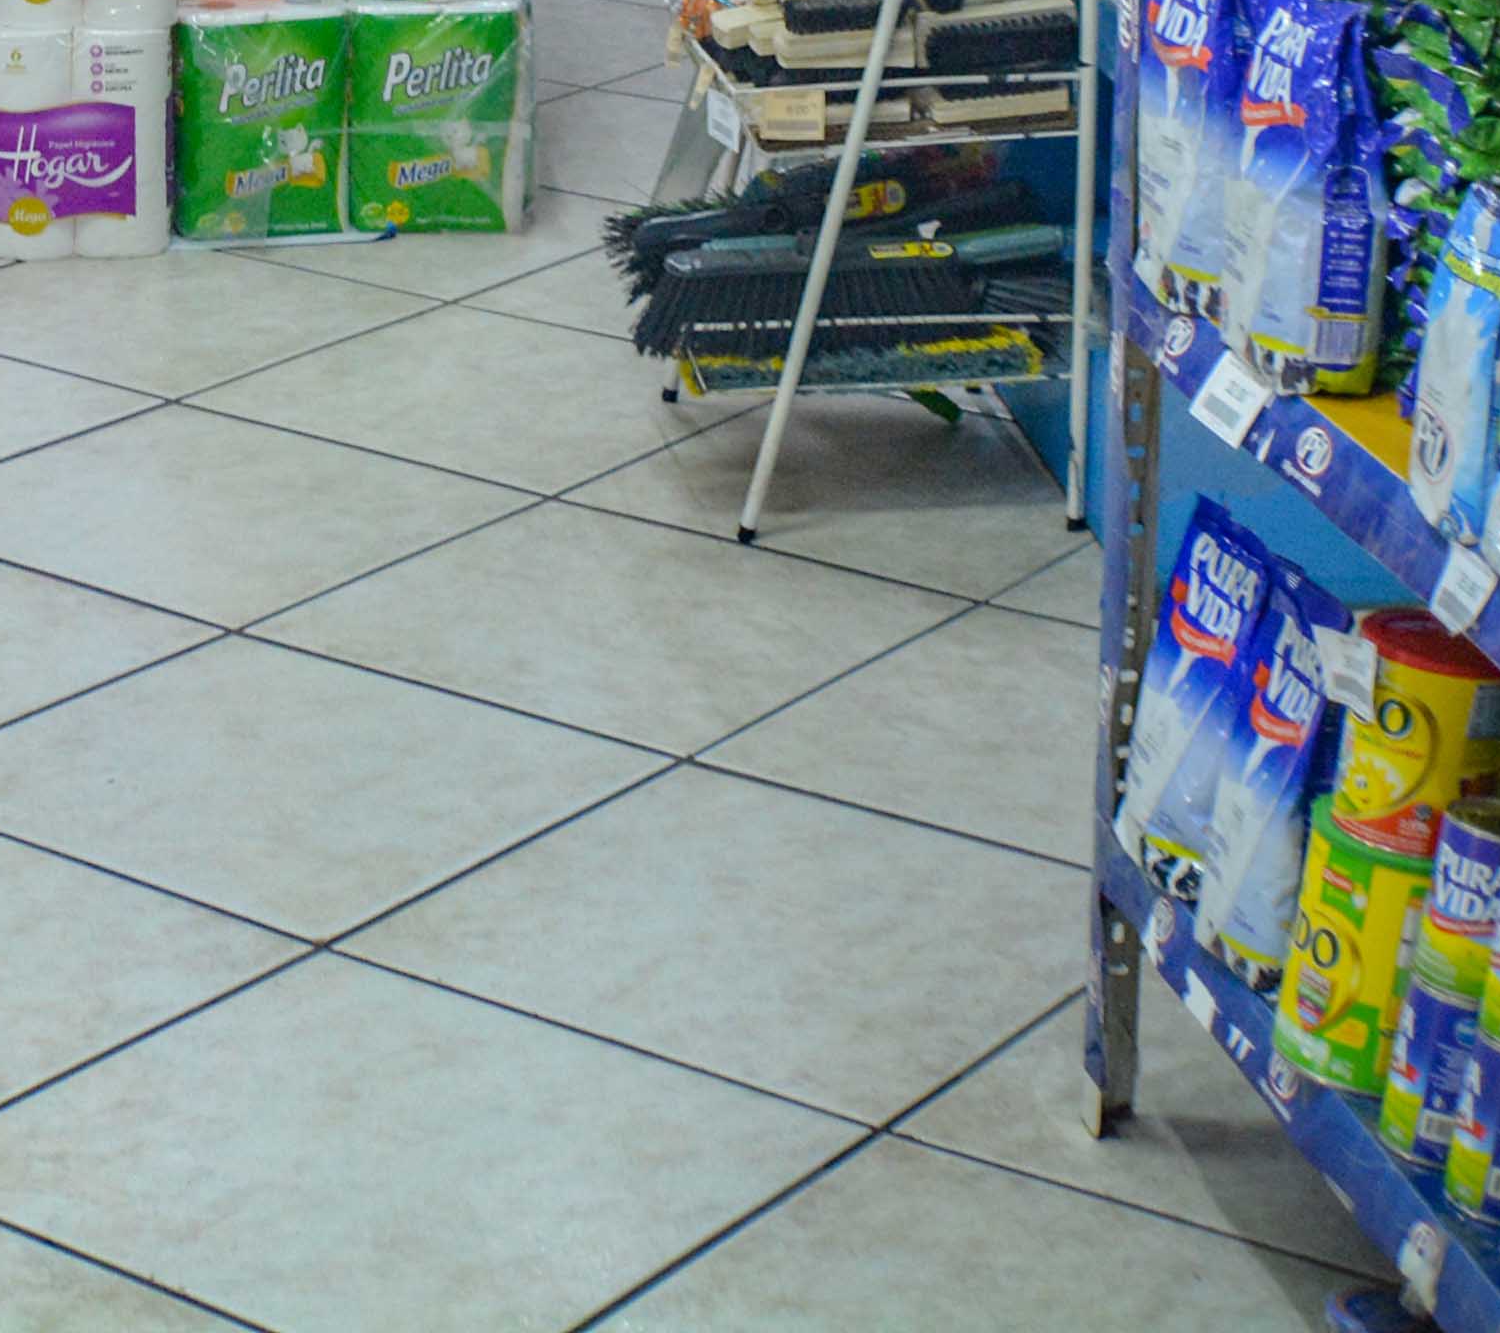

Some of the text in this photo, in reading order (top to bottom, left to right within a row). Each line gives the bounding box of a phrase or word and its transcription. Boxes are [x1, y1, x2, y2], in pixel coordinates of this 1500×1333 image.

[218, 51, 327, 113] Perlita
[381, 45, 493, 102] Perlita
[397, 158, 450, 186] Mega
[1190, 532, 1260, 610] PURA
[1187, 570, 1243, 646] VIDA
